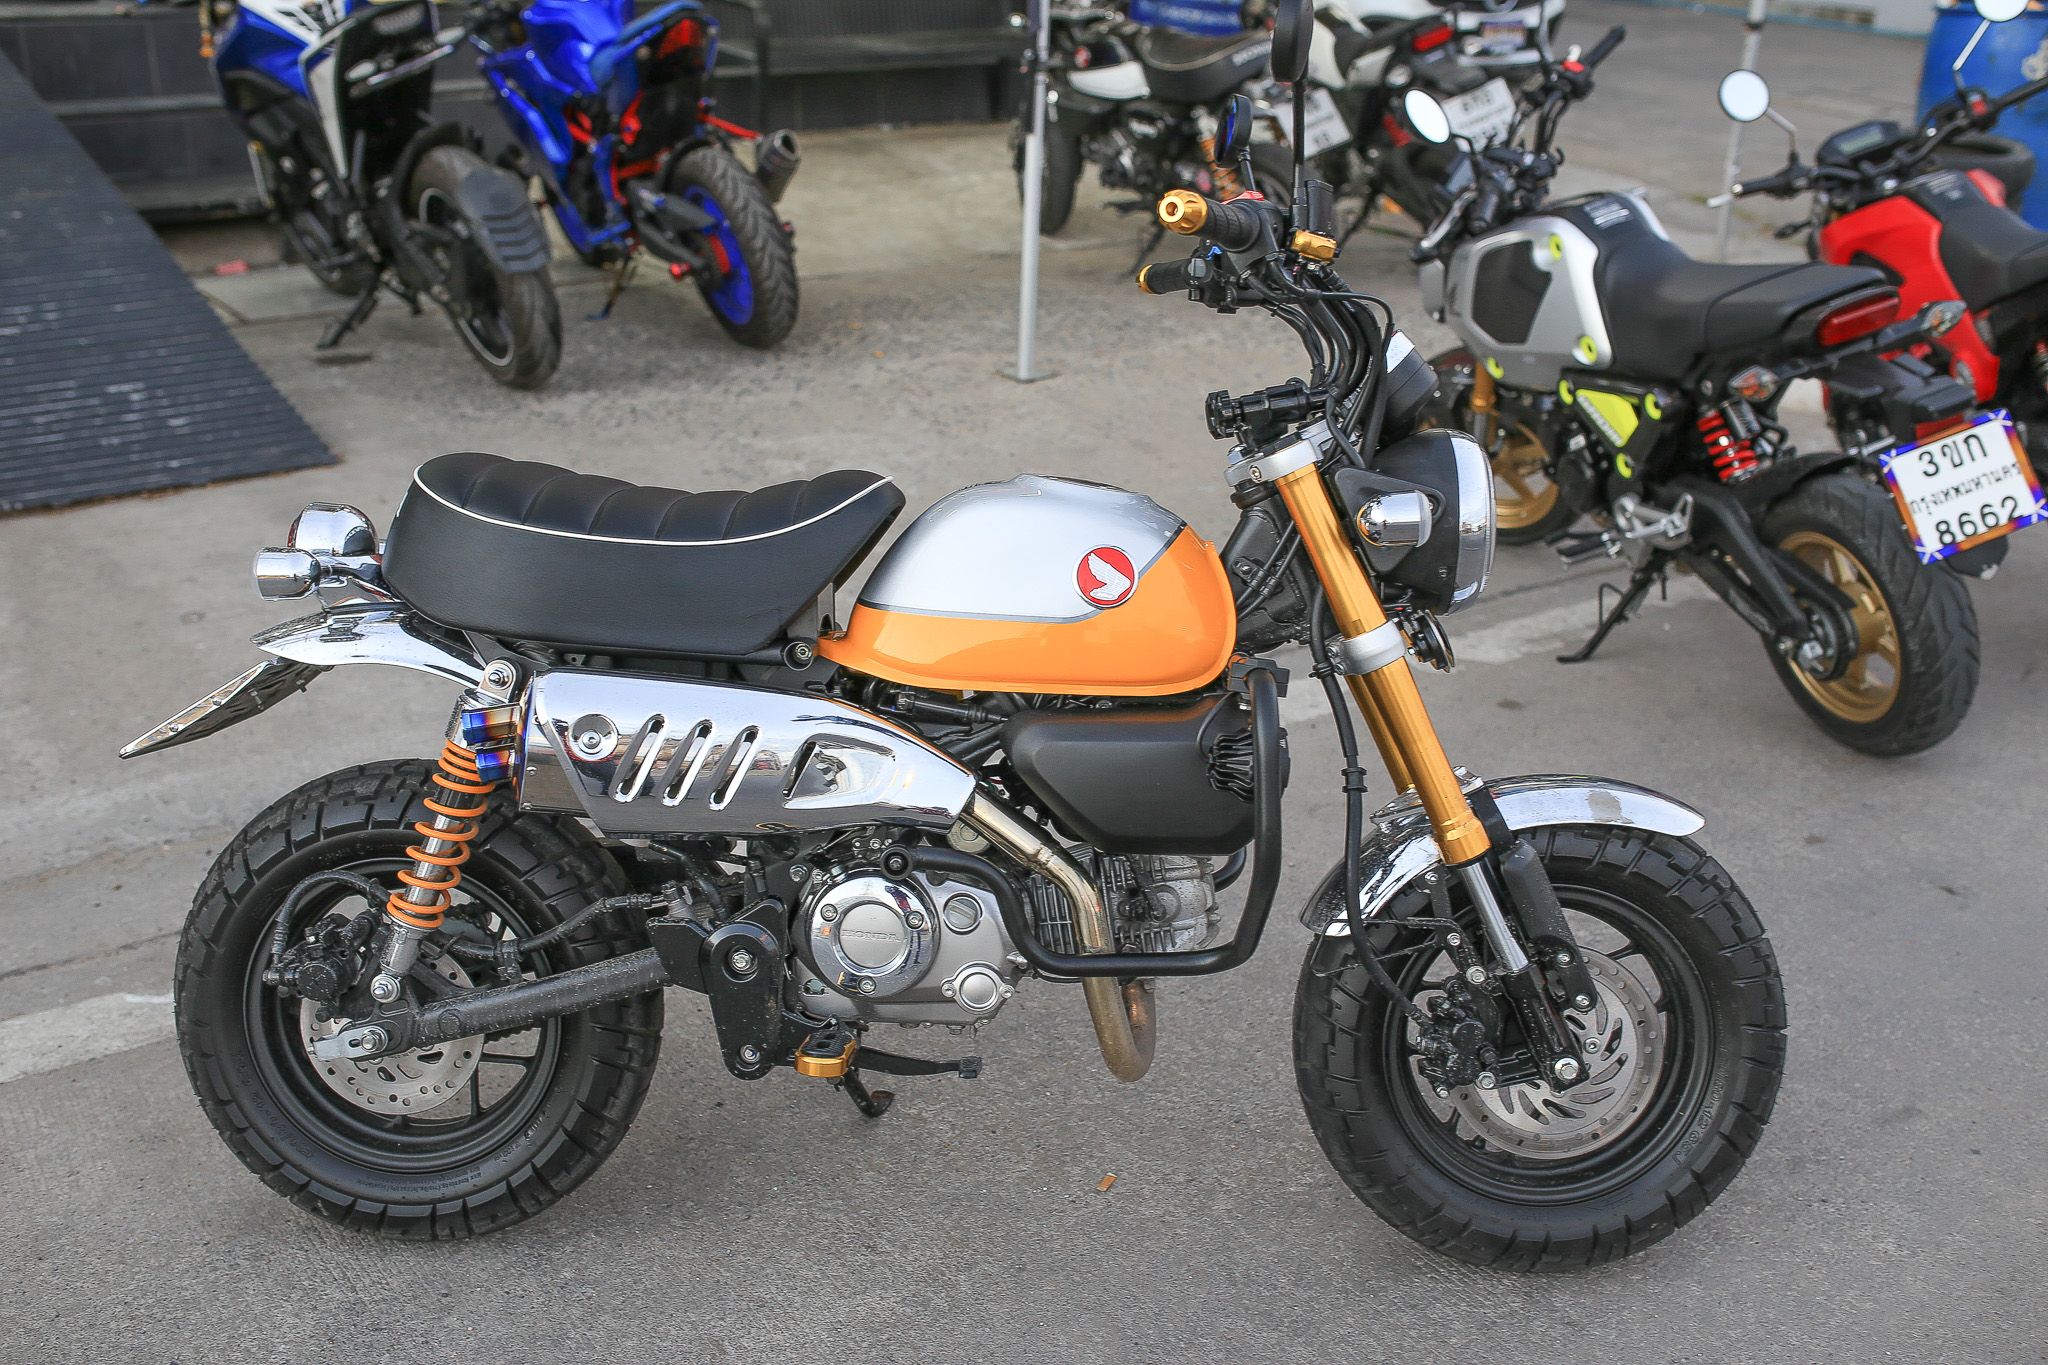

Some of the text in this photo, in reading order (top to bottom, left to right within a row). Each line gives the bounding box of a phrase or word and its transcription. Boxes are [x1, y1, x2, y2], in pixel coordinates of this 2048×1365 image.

[1918, 433, 1987, 477] 3ขก
[1935, 496, 2024, 546] 8662
[841, 929, 901, 943] HONDA
